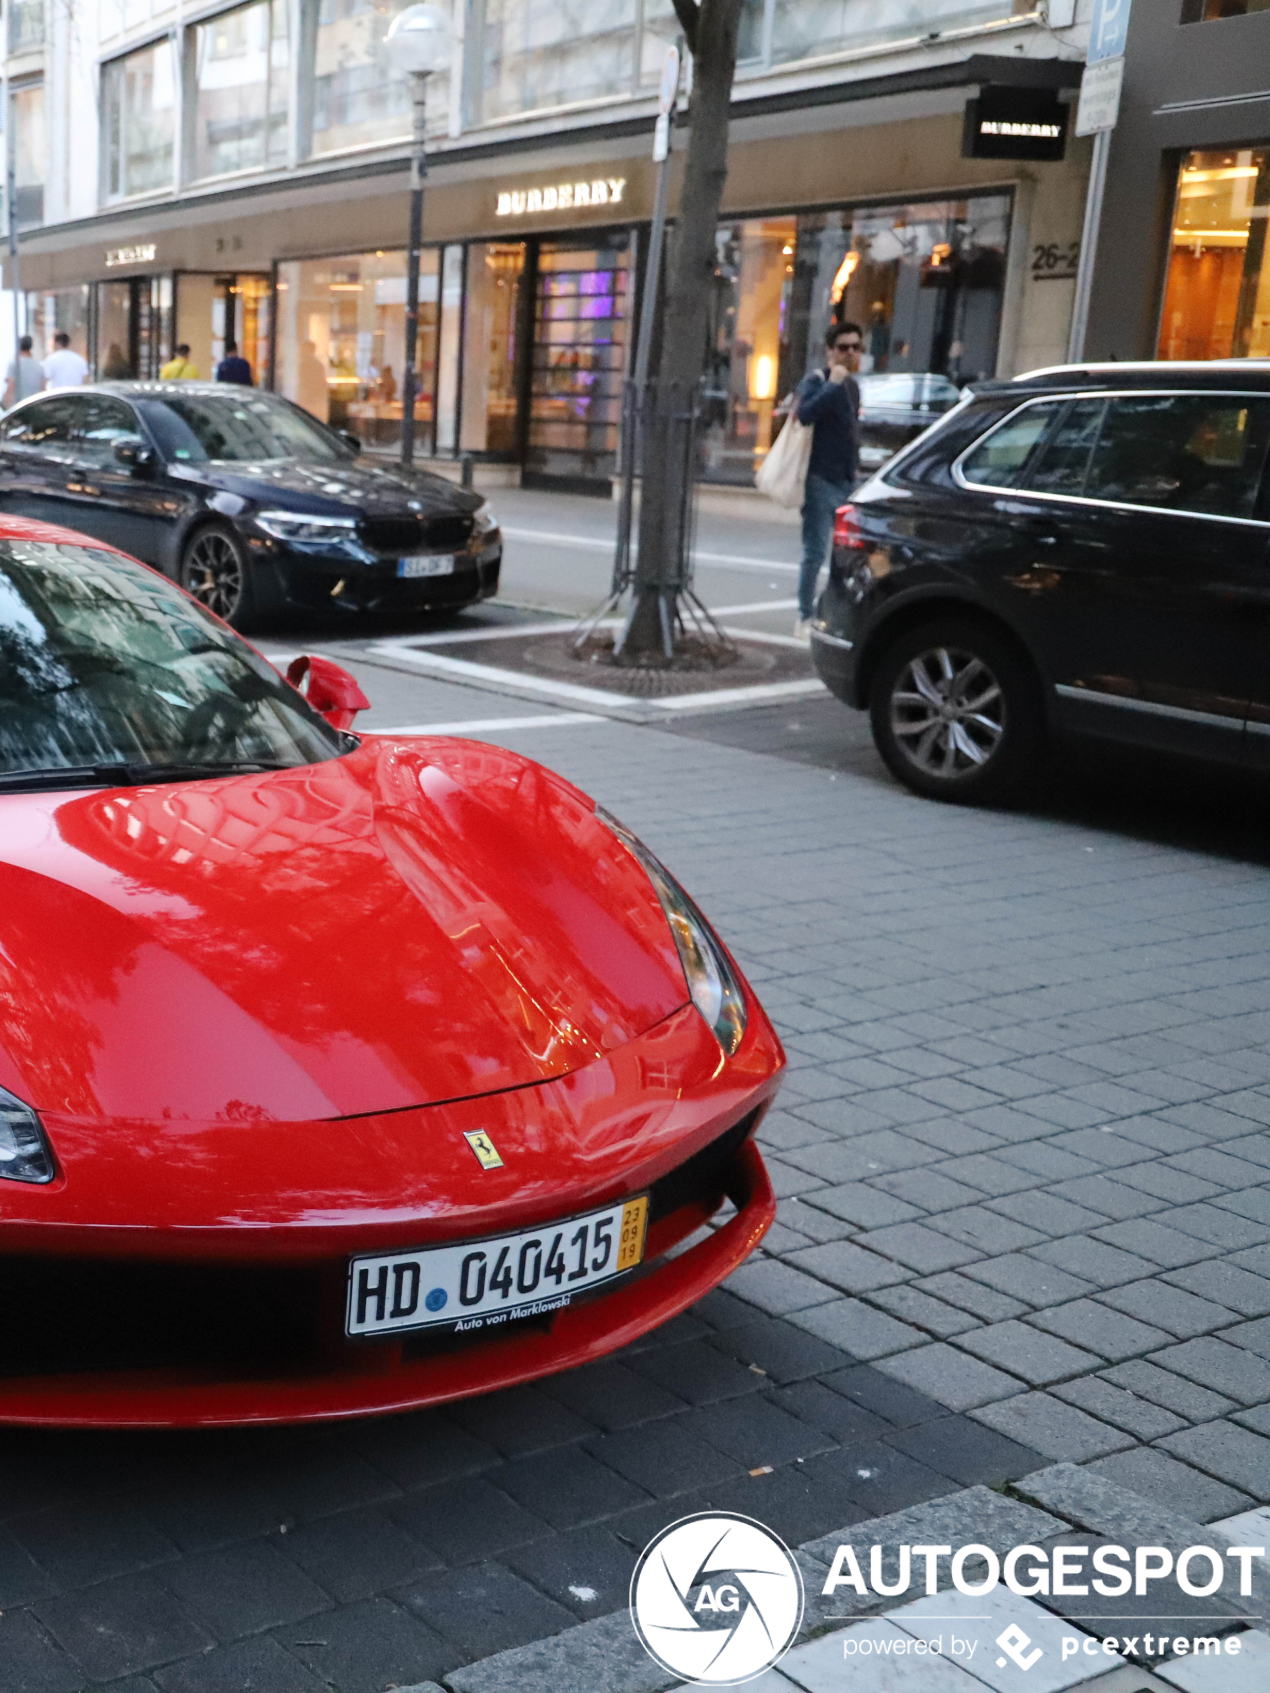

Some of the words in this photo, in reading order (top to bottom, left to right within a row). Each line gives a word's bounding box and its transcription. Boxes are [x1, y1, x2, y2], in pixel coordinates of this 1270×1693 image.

[980, 121, 1061, 137] BURBERRY
[495, 177, 627, 215] BURBERRY
[1031, 242, 1080, 270] 26-2
[624, 1206, 640, 1226] 23
[622, 1225, 638, 1243] 09
[622, 1243, 636, 1260] 19
[356, 1261, 421, 1324] HD
[459, 1216, 614, 1306] 040415
[454, 1319, 483, 1332] Auto
[486, 1313, 508, 1325] von
[510, 1294, 572, 1320] Marklowski
